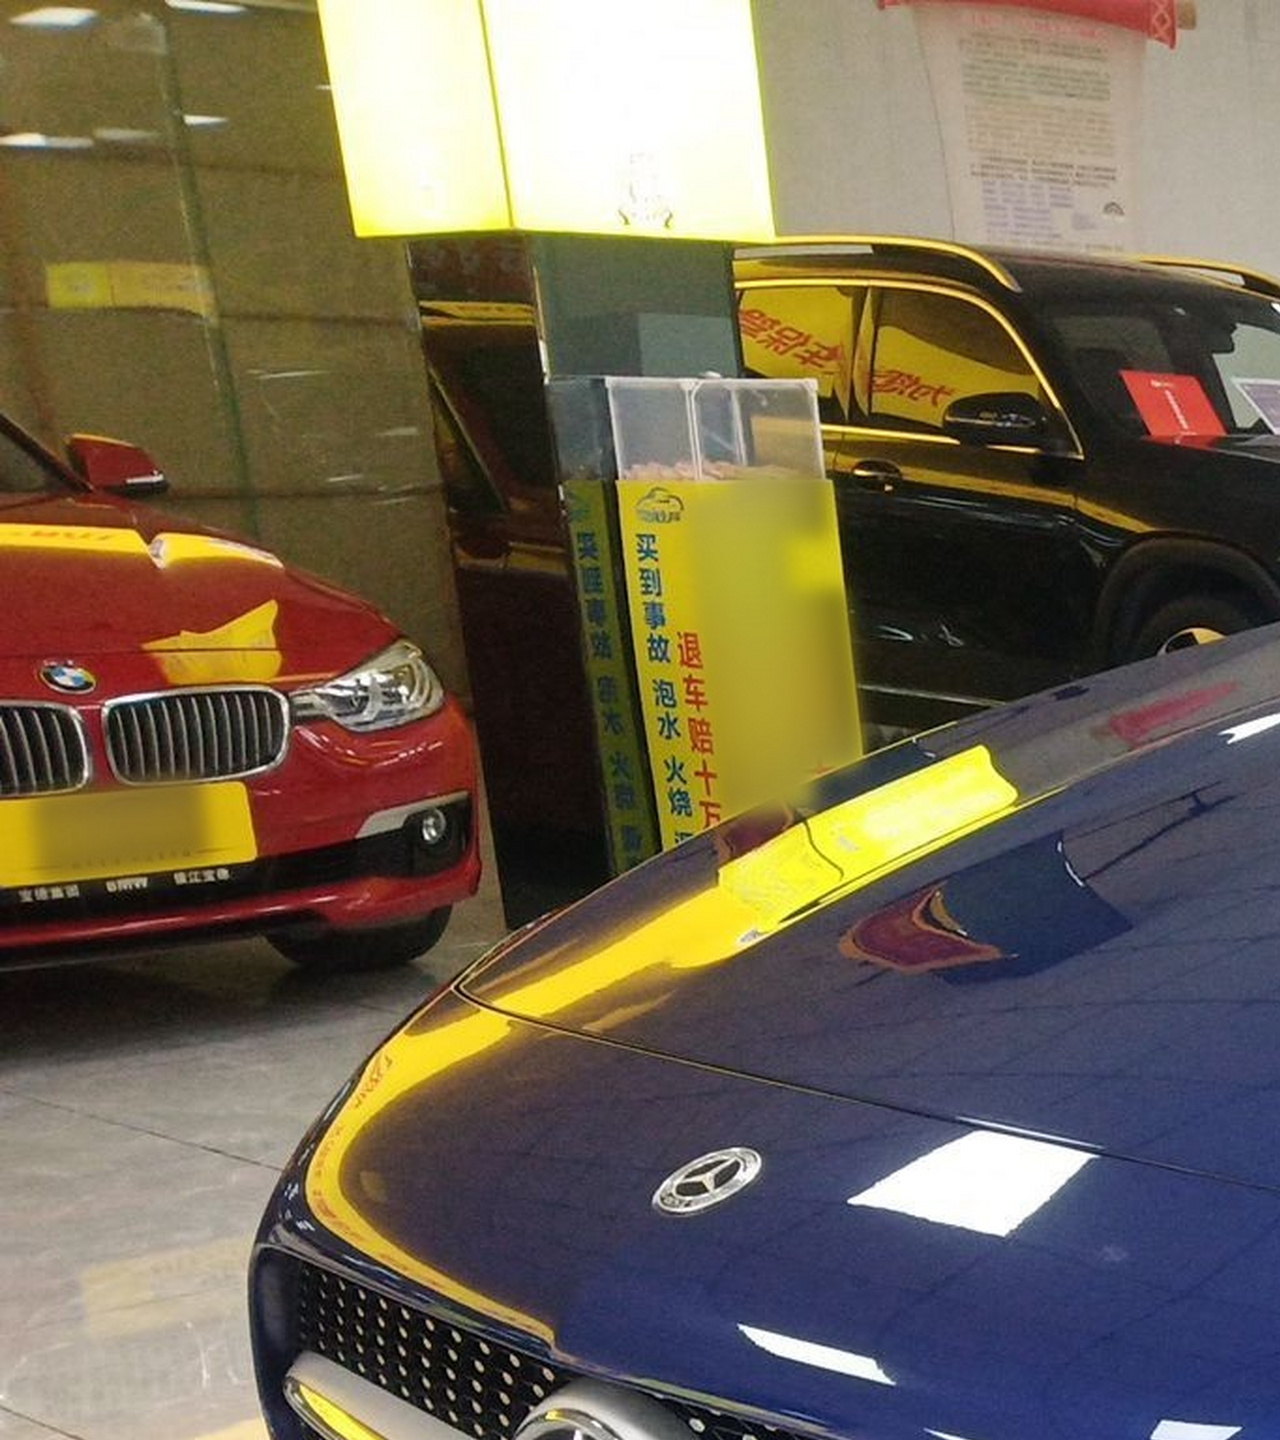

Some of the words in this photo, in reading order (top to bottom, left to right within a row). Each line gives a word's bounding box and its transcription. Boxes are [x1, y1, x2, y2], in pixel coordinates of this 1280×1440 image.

[635, 533, 671, 663] 买到事故
[652, 678, 681, 740] 泡水
[677, 630, 722, 828] 退车赔十万
[664, 755, 693, 817] 火烧
[105, 876, 149, 893] BMW
